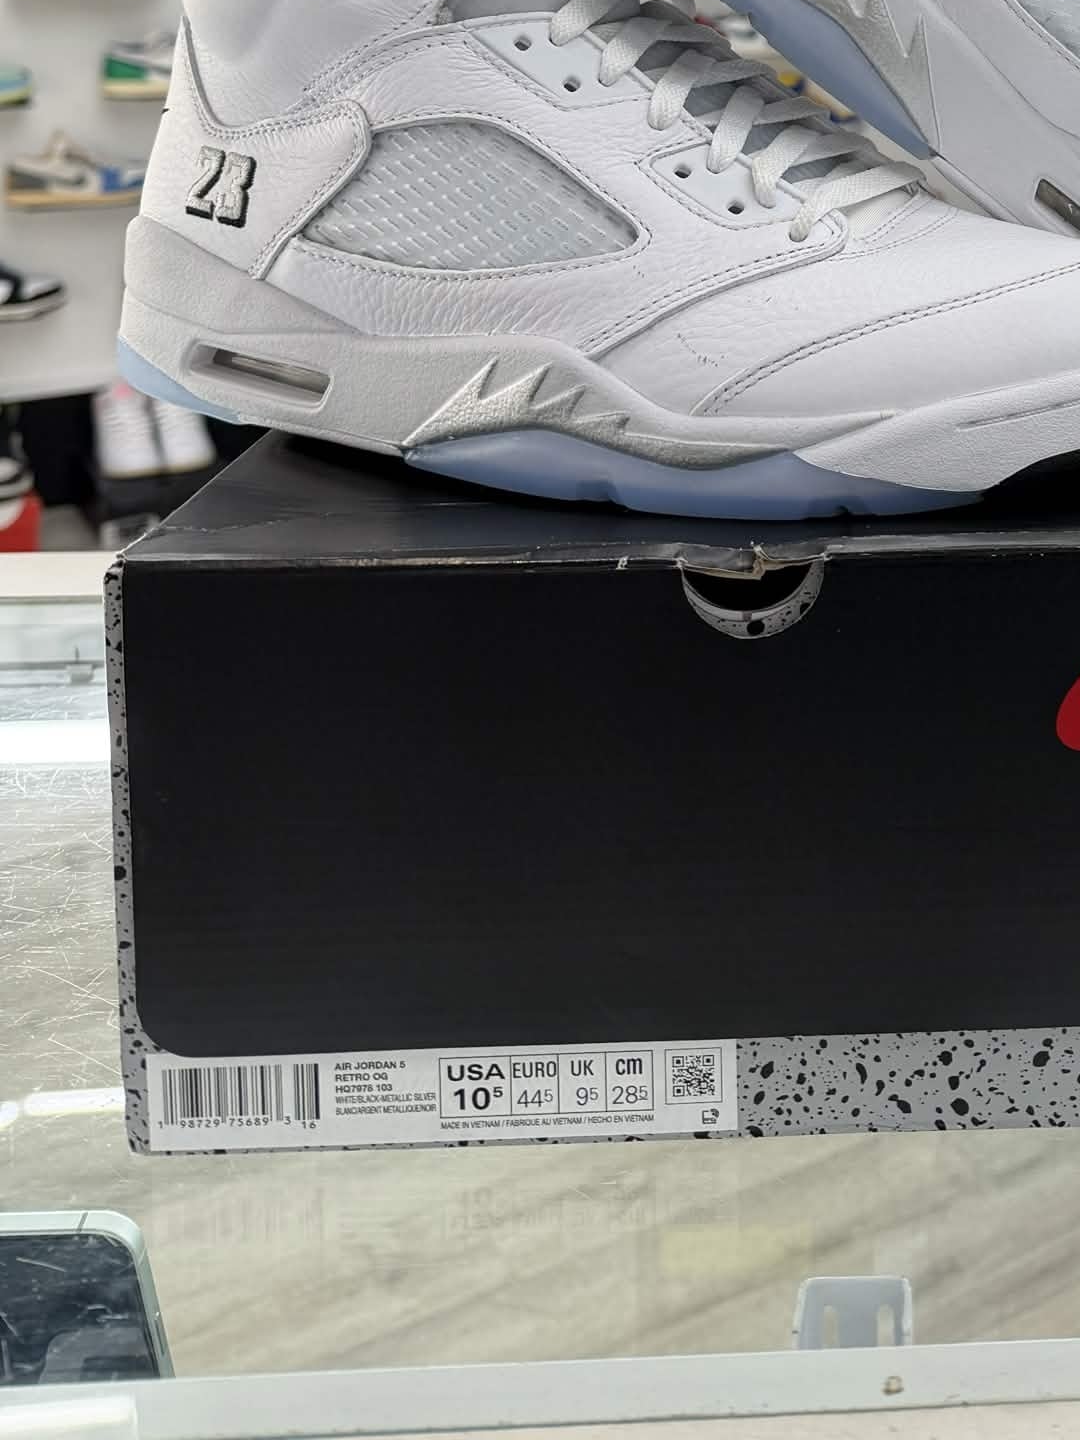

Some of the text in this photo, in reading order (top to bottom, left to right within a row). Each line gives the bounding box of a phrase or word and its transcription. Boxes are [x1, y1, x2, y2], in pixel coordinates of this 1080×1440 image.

[185, 146, 256, 228] 23
[335, 1061, 406, 1071] AIR JORDAN 5
[447, 1063, 505, 1081] USA
[512, 1061, 557, 1078] EURO
[570, 1060, 594, 1076] UK
[615, 1058, 643, 1075] cm
[335, 1072, 388, 1082] RETRO OG
[158, 1120, 163, 1129] 1
[229, 1117, 269, 1127] 75689
[284, 1116, 291, 1125] 3
[302, 1121, 316, 1129] 16
[440, 1121, 460, 1129] MADE
[470, 1120, 500, 1129] VIETNAM
[542, 1118, 550, 1126] AU
[552, 1117, 582, 1126] VIETNAM
[588, 1116, 612, 1124] HECHO
[614, 1115, 623, 1123] EN
[625, 1114, 654, 1123] VIETNAM
